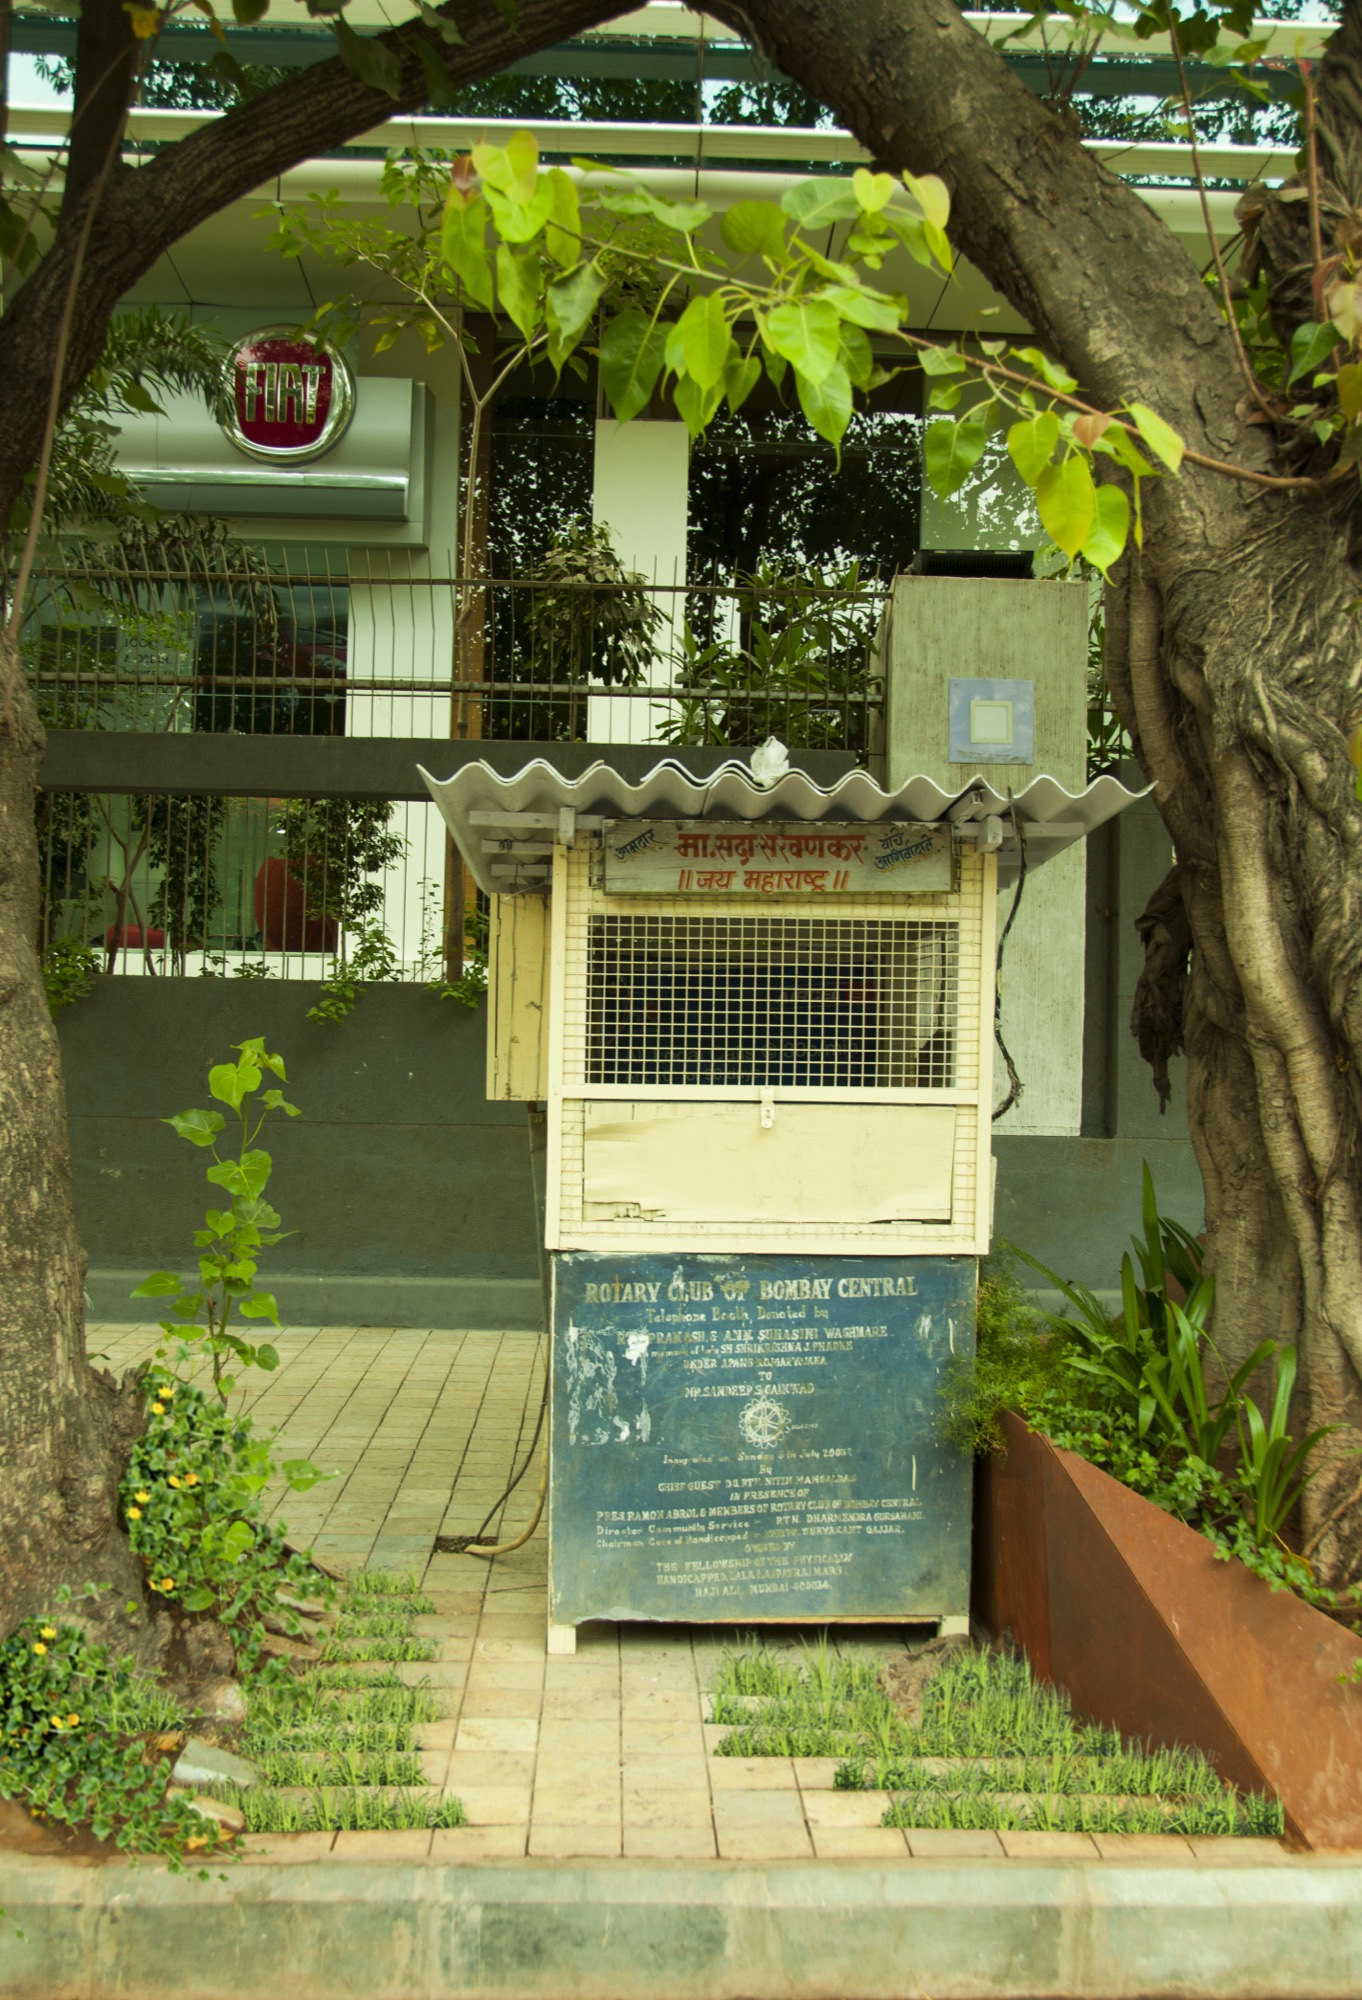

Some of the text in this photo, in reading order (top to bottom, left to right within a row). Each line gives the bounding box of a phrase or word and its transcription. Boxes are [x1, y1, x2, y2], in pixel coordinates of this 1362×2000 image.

[246, 363, 326, 424] FIAT
[584, 1282, 662, 1303] ROTARY
[667, 1281, 714, 1302] CLUB
[759, 1278, 833, 1300] BOMBAY
[838, 1276, 919, 1298] CENTRAL
[646, 1307, 707, 1325] Telephone
[757, 1305, 806, 1320] Donated
[814, 1304, 830, 1320] by
[757, 1327, 818, 1341] SUHASINI
[823, 1325, 888, 1339] WAGHMARE
[758, 1371, 773, 1381] TO
[759, 1464, 773, 1476] By
[708, 1504, 756, 1518] MEMBERS
[596, 1524, 643, 1537] Director
[648, 1522, 706, 1535] Community
[708, 1519, 751, 1531] Service
[596, 1538, 644, 1549] Chairman
[685, 1531, 749, 1546] Handicapped
[656, 1562, 678, 1573] THE
[684, 1559, 752, 1572] FELLOWSHIP
